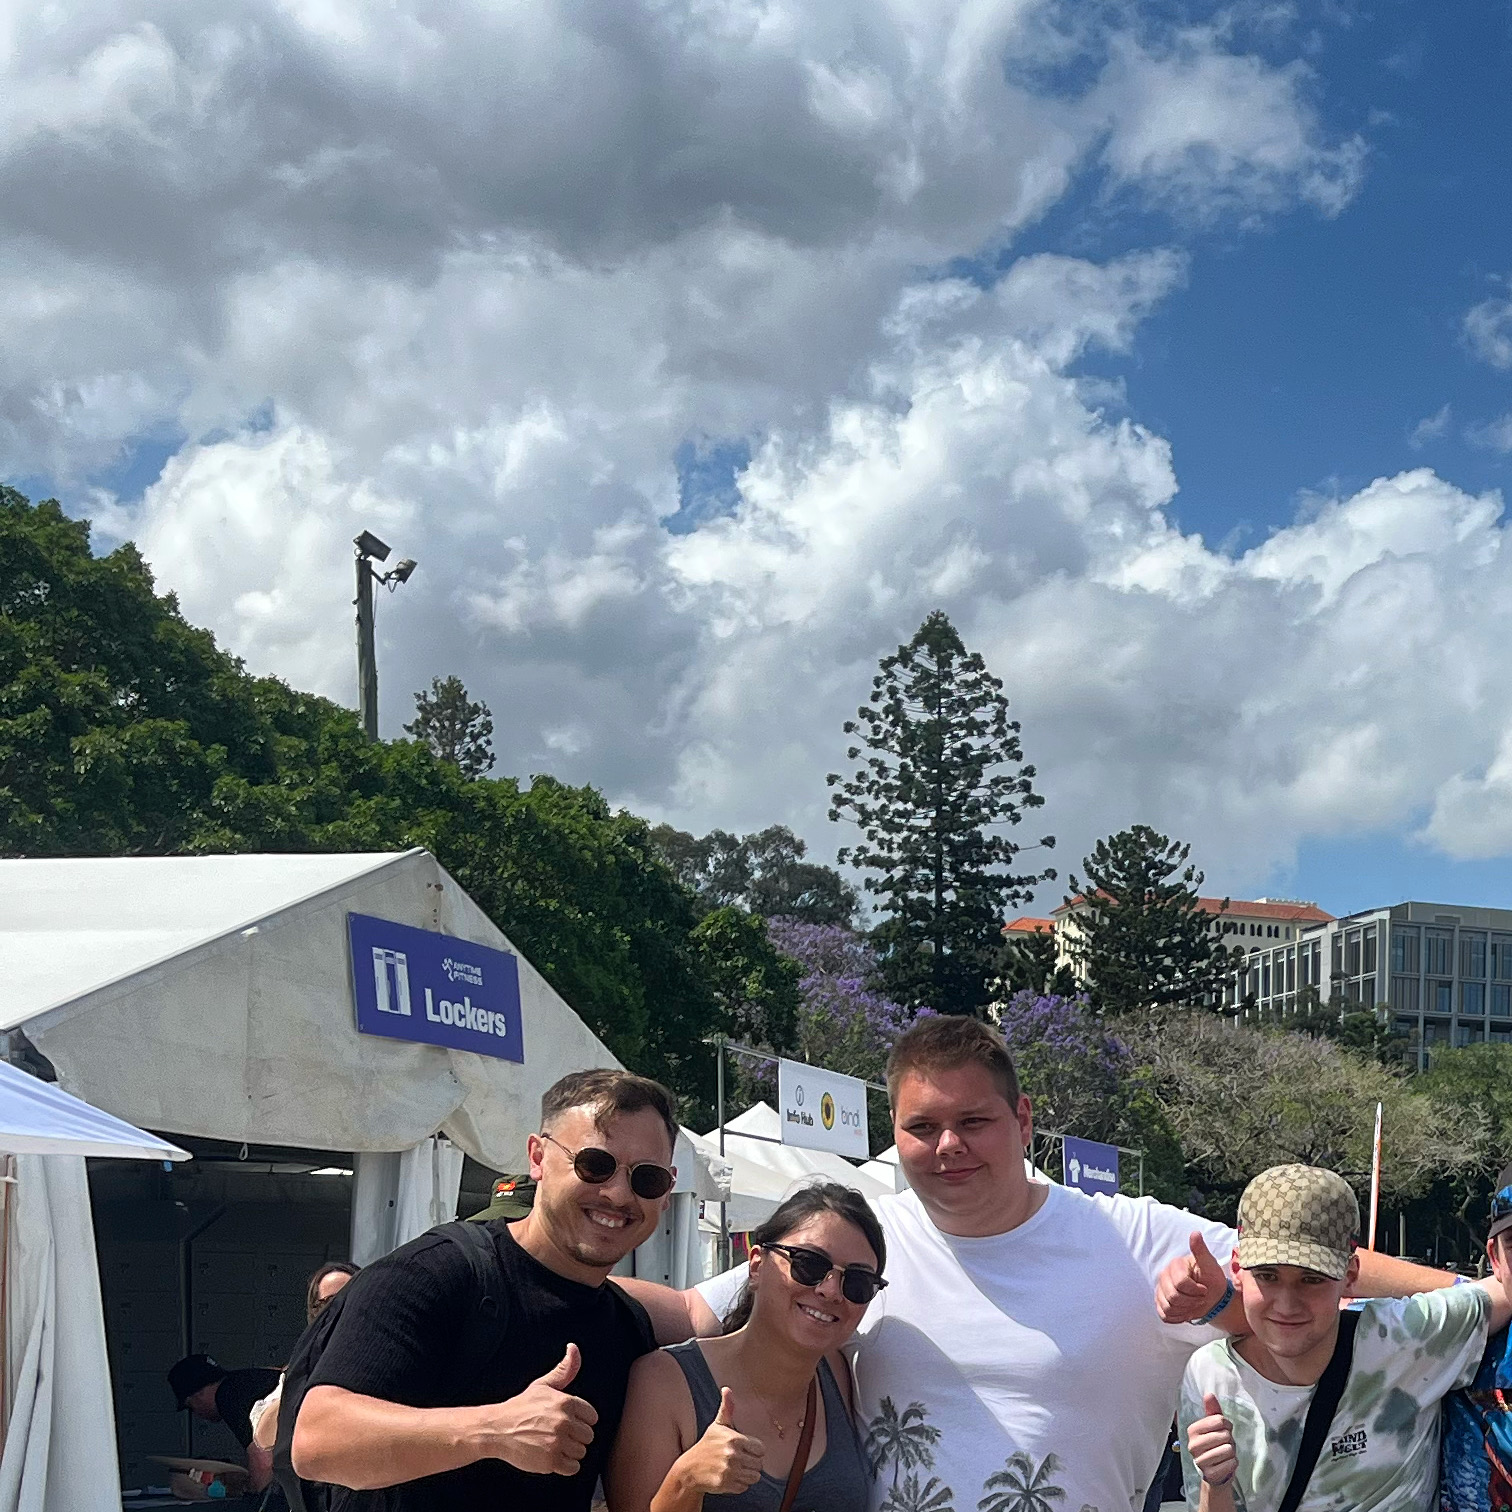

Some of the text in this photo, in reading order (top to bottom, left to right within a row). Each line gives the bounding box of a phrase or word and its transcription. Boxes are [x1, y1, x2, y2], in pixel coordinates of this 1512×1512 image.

[454, 962, 481, 976] ANYTIME
[454, 971, 483, 985] FITNESS
[424, 987, 507, 1037] Lockers
